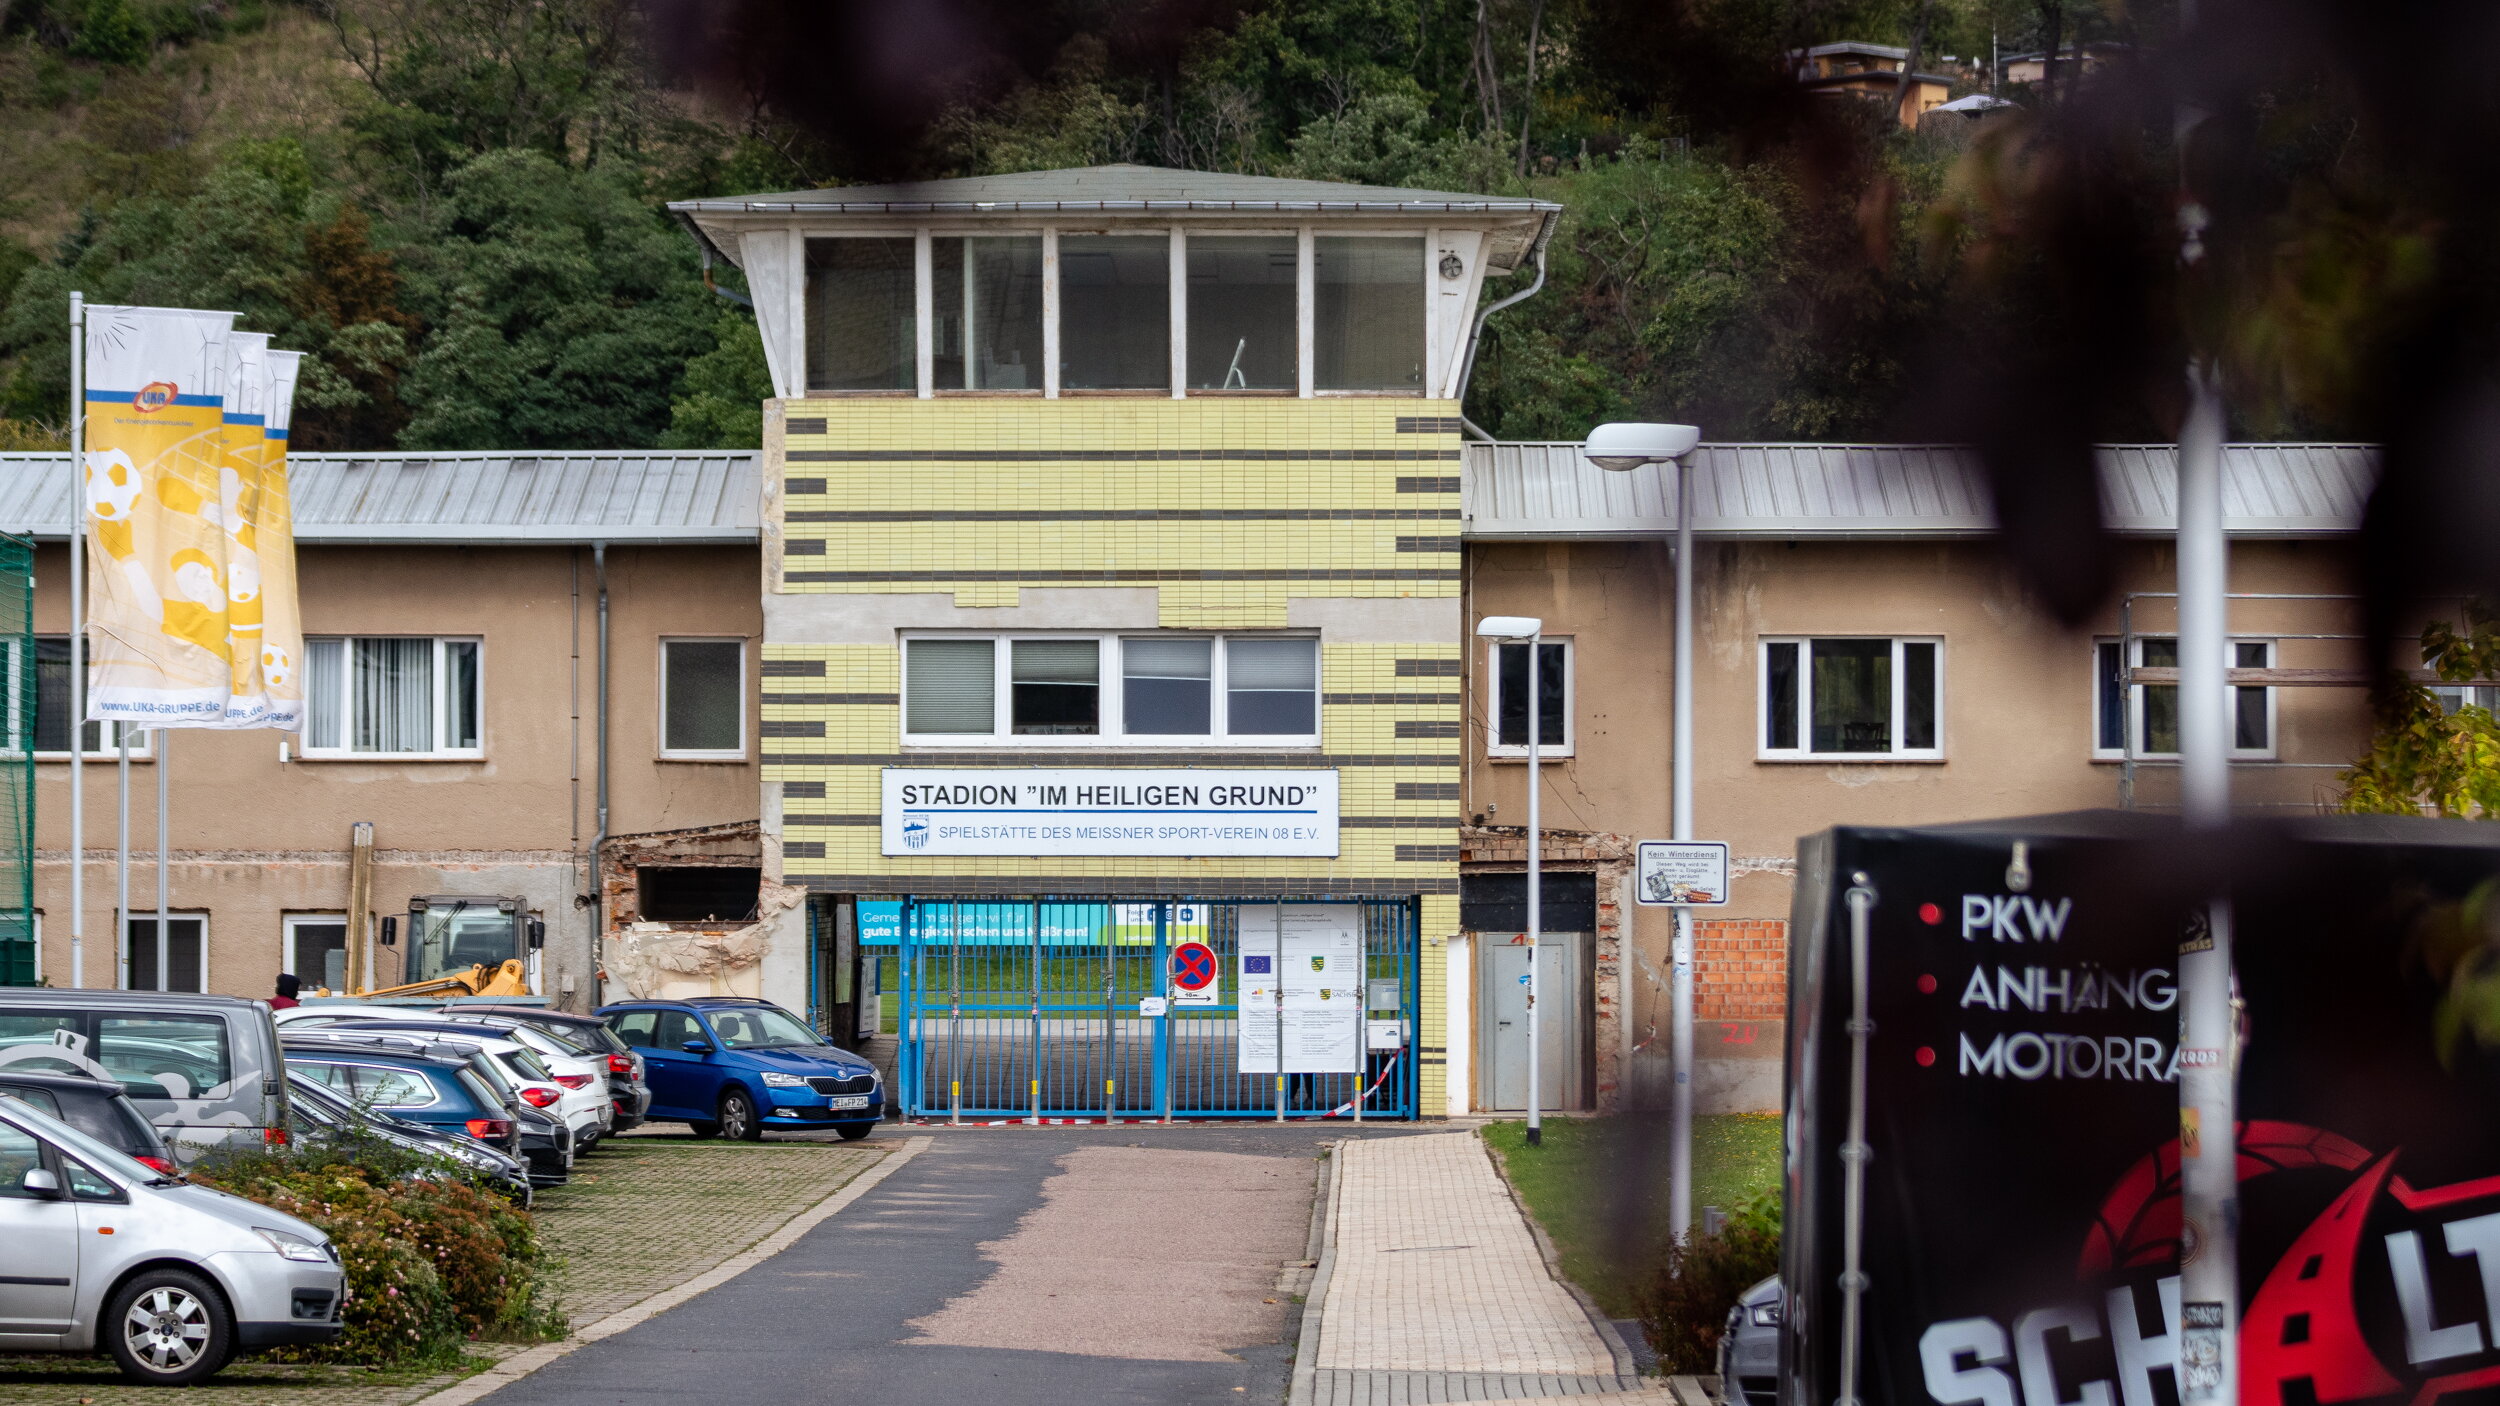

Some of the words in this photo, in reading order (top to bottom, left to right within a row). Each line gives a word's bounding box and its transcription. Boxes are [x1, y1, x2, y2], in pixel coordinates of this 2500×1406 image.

[142, 391, 167, 405] UKA
[100, 701, 220, 714] www.UKA-GRUPPE.de
[901, 784, 1017, 805] STADION
[1076, 785, 1199, 806] HEILIGEN
[938, 825, 1037, 839] SPIELSTÄTTE
[1041, 827, 1072, 839] DES
[1076, 827, 1154, 839] MEISSNER
[1158, 827, 1268, 839] SPORT-VEREIN
[1272, 827, 1289, 839] 08
[1293, 827, 1320, 839] E.V.
[863, 912, 936, 924] Gemesm
[939, 913, 981, 926] sogen
[1961, 893, 2072, 943] PKW
[862, 926, 892, 939] gute
[894, 926, 941, 939] Eegie
[1002, 927, 1025, 938] uns
